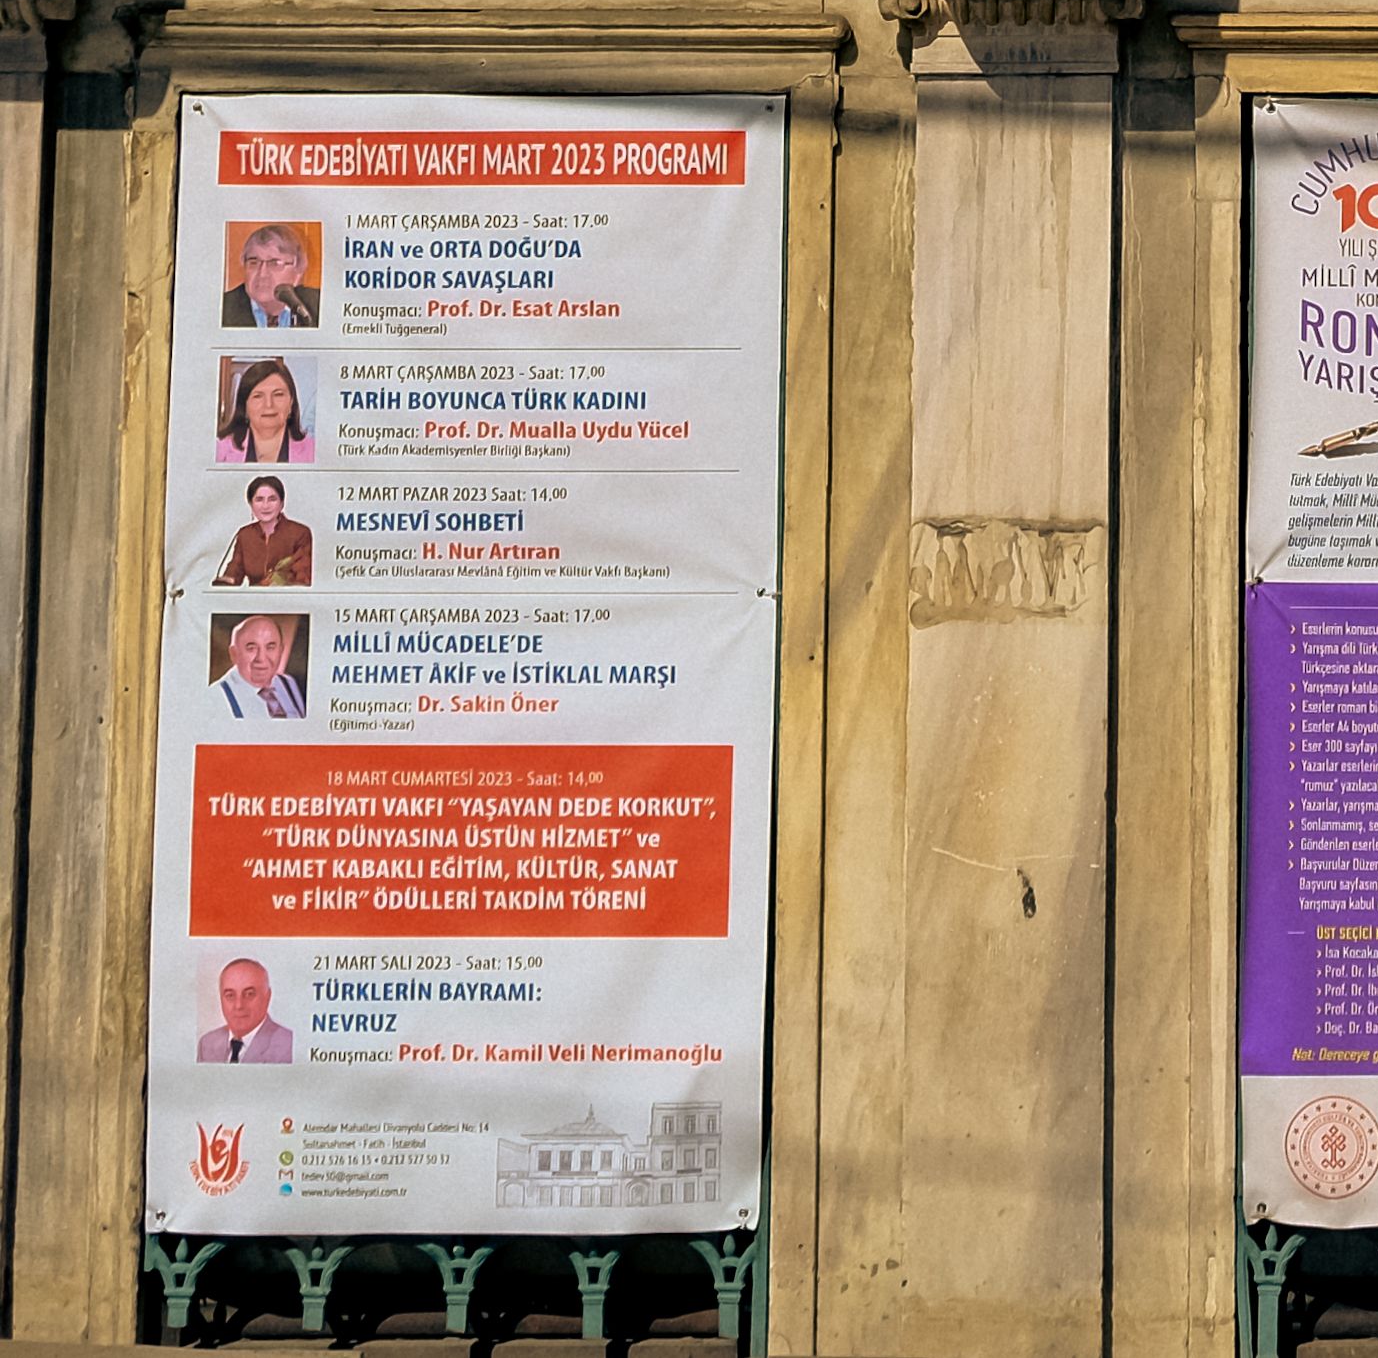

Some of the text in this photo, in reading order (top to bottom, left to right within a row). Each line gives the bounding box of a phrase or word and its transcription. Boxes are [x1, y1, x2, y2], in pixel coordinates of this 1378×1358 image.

[236, 137, 728, 178] TÜRK EDEBİYATI VAKFI MART 2023 PROGRAMI
[346, 213, 352, 229] 1
[356, 213, 398, 229] MART
[400, 213, 481, 233] ÇARŞAMBA
[483, 213, 519, 230] 2023
[532, 213, 568, 229] Saat:
[345, 236, 394, 259] İRAN
[400, 245, 424, 259] ve
[430, 240, 482, 259] ORTA
[1338, 237, 1364, 259] YILI
[345, 266, 553, 294] KORİDOR SAVAŞLARI
[1302, 264, 1357, 288] MİLLÎ
[343, 299, 620, 321] Konuşmacı: Prof. Dr. Esat Arslan
[339, 386, 646, 411] TARİH BOYUNCA TÜRK KADINI
[338, 420, 689, 443] Konuşmacı: Prof. Dr. Mualla Uydu Yücel
[1290, 473, 1312, 487] Türk
[1314, 472, 1363, 490] Edebiyatı
[338, 486, 355, 501] 12
[358, 486, 400, 502] MART
[403, 486, 449, 502] PAZAR
[452, 487, 487, 502] 2023
[490, 486, 527, 502] Saat:
[336, 509, 524, 532] MESNEVÎ SOHBETİ
[335, 541, 560, 564] Konuşmacı: H. Nur Artıran
[333, 630, 390, 653] MİLLÎ
[332, 661, 676, 688] MEHMET ÂKİF ve İSTİKLAL MARŞI
[418, 695, 445, 713] Dr.
[450, 694, 505, 713] Sakin
[511, 692, 560, 713] Öner
[208, 792, 265, 816] TÜRK
[270, 793, 377, 819] EDEBİYATI
[382, 797, 444, 817] VAKFI
[558, 797, 612, 817] DEDE
[334, 824, 458, 850] DÜNYASINA
[465, 824, 535, 848] ÜSTÜN
[636, 832, 661, 848] ve
[332, 859, 424, 879] KABAKLI
[430, 855, 510, 882] EĞİTİM,
[516, 855, 605, 883] KÜLTÜR,
[610, 859, 678, 879] SANAT
[272, 894, 297, 910] ve
[373, 886, 477, 910] ÖDÜLLERİ
[482, 886, 564, 910] TAKDİM
[570, 886, 648, 913] TÖRENİ
[1316, 924, 1336, 941] ÜST
[1339, 924, 1373, 943] SEÇİCİ
[312, 977, 542, 1002] TÜRKLERİN BAYRAMI:
[312, 1013, 397, 1033] NEVRUZ
[310, 1043, 722, 1066] Konuşmacı: Prof. Dr. Kamil Veli Nerimanoğlu
